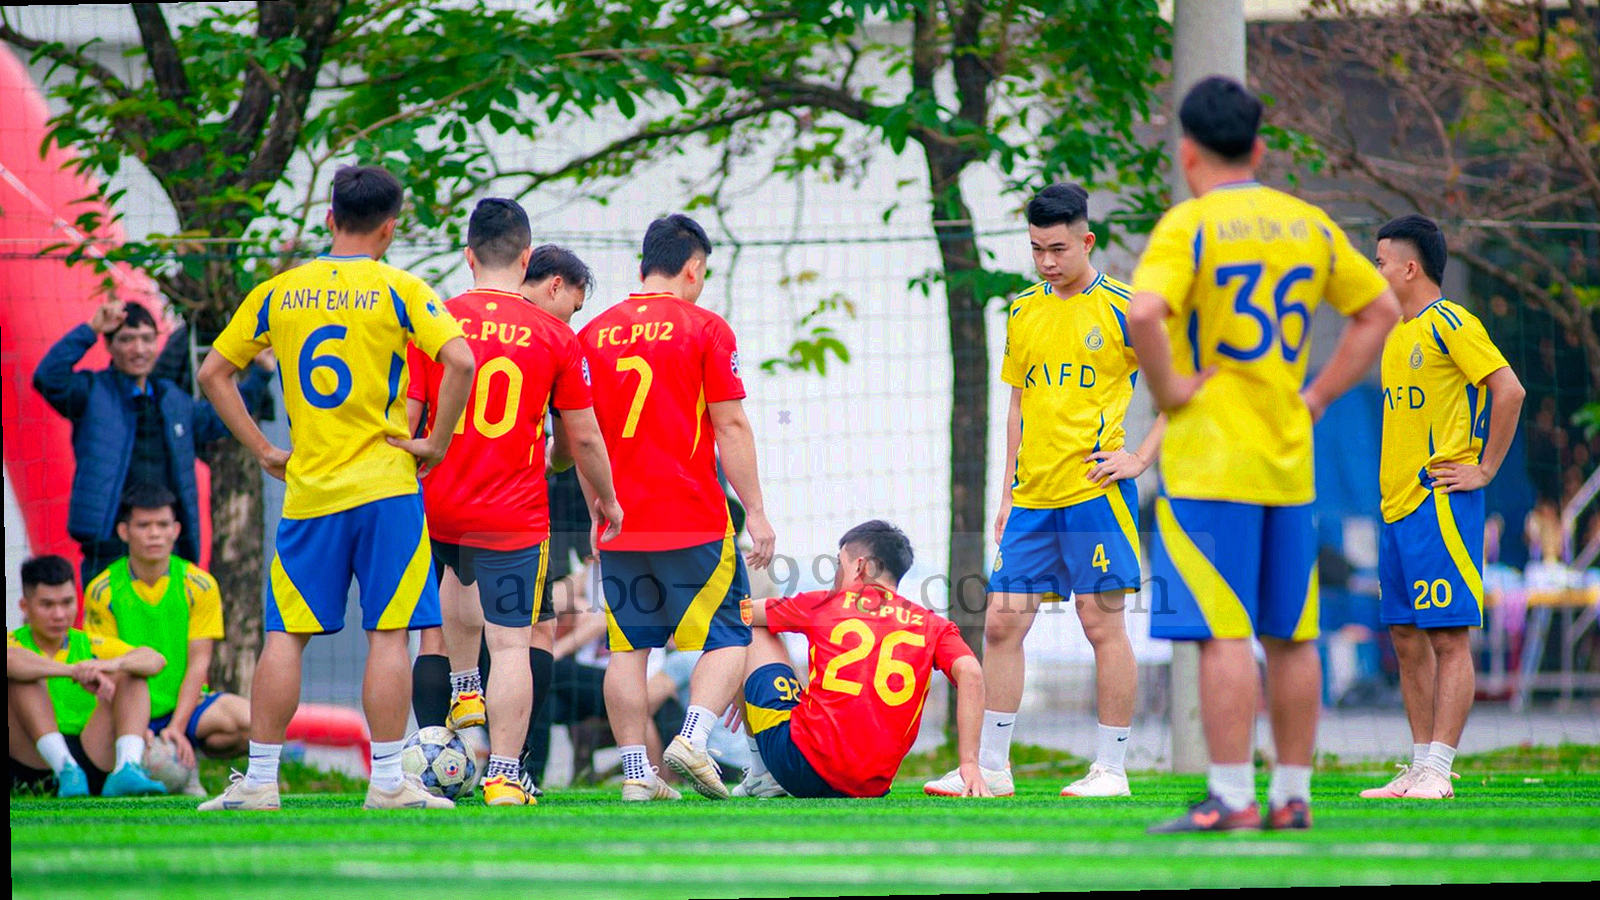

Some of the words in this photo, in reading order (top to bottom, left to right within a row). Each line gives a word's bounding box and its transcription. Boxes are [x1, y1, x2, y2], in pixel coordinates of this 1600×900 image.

[281, 289, 321, 310] ANH
[326, 289, 349, 310] EM
[354, 290, 380, 310] WF
[597, 321, 674, 348] FC.PU2
[1216, 263, 1315, 363] 36
[298, 323, 353, 410] 6
[453, 356, 523, 439] 0
[616, 355, 653, 438] 7
[1092, 543, 1110, 573] 4
[1413, 578, 1452, 610] 20
[822, 618, 925, 707] 26
